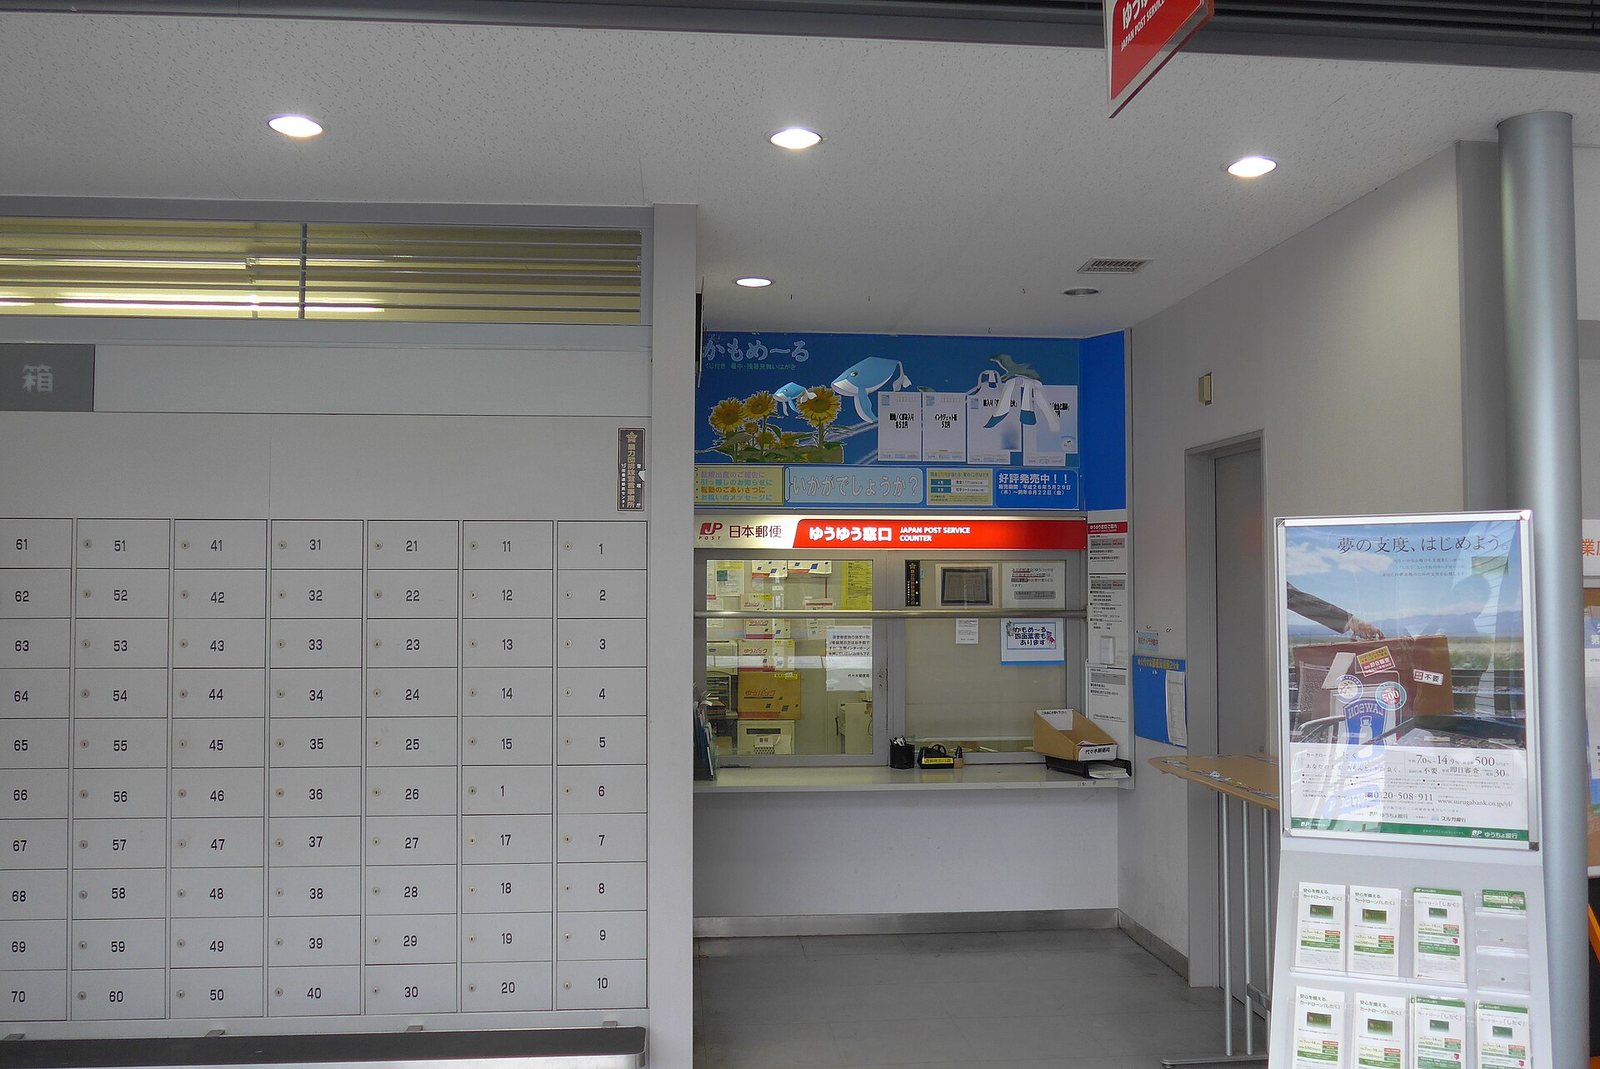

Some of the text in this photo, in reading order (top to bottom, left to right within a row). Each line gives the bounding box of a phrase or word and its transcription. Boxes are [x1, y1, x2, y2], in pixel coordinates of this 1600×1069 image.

[1121, 29, 1135, 52] JAPAN
[1134, 15, 1146, 36] POST
[22, 364, 54, 393] 箱
[729, 525, 782, 538] 日本郵便
[809, 526, 892, 542] ゆうゆう窓口
[900, 526, 971, 534] JAPAN POST SERVICE
[15, 538, 28, 551] 61
[114, 540, 126, 552] 51
[210, 539, 223, 552] 41
[309, 538, 321, 551] 31
[405, 540, 418, 552] 21
[502, 540, 511, 553] 11
[1337, 536, 1509, 554] 夢の支度、はじめよう。
[15, 590, 30, 603] 62
[113, 589, 128, 602] 52
[210, 591, 225, 604] 42
[308, 589, 323, 602] 32
[405, 589, 420, 602] 22
[502, 589, 513, 601] 12
[599, 589, 606, 601] 2
[15, 640, 30, 652] 63
[113, 639, 128, 652] 53
[209, 639, 225, 652] 43
[308, 638, 323, 651] 33
[406, 638, 420, 651] 23
[502, 638, 513, 651] 13
[599, 638, 606, 650] 3
[1424, 673, 1440, 683] 不要
[14, 690, 29, 703] 64
[112, 689, 128, 702] 54
[208, 688, 224, 701] 44
[309, 689, 324, 702] 34
[405, 688, 420, 701] 24
[501, 687, 513, 700] 14
[598, 687, 606, 700] 4
[1382, 690, 1400, 702] 500
[14, 739, 29, 752] 65
[113, 739, 128, 752] 55
[209, 739, 224, 752] 45
[309, 738, 324, 750] 35
[405, 738, 420, 751] 25
[501, 738, 513, 750] 15
[599, 736, 606, 748] 5
[13, 789, 28, 801] 66
[113, 790, 128, 803] 56
[209, 789, 225, 802] 46
[308, 788, 323, 800] 36
[405, 788, 419, 800] 26
[598, 785, 605, 797] 6
[1373, 791, 1433, 801] 020-508-911
[12, 839, 27, 852] 67
[112, 839, 127, 851] 57
[210, 838, 225, 851] 47
[308, 835, 323, 848] 37
[405, 837, 419, 849] 27
[500, 834, 512, 846] 17
[598, 834, 606, 846] 7
[111, 887, 126, 900] 58
[209, 887, 224, 900] 48
[309, 887, 324, 900] 38
[404, 886, 418, 898] 28
[500, 882, 512, 894] 18
[598, 882, 605, 895] 8
[11, 890, 27, 903] 68
[403, 935, 418, 947] 29
[501, 932, 513, 945] 19
[599, 929, 606, 941] 9
[11, 941, 26, 953] 69
[111, 940, 125, 953] 59
[209, 940, 224, 953] 49
[308, 937, 323, 950] 39
[501, 981, 516, 994] 20
[597, 977, 608, 989] 10
[11, 990, 26, 1003] 70
[109, 990, 124, 1003] 60
[209, 989, 224, 1001] 50
[306, 987, 322, 1000] 40
[404, 986, 419, 998] 30
